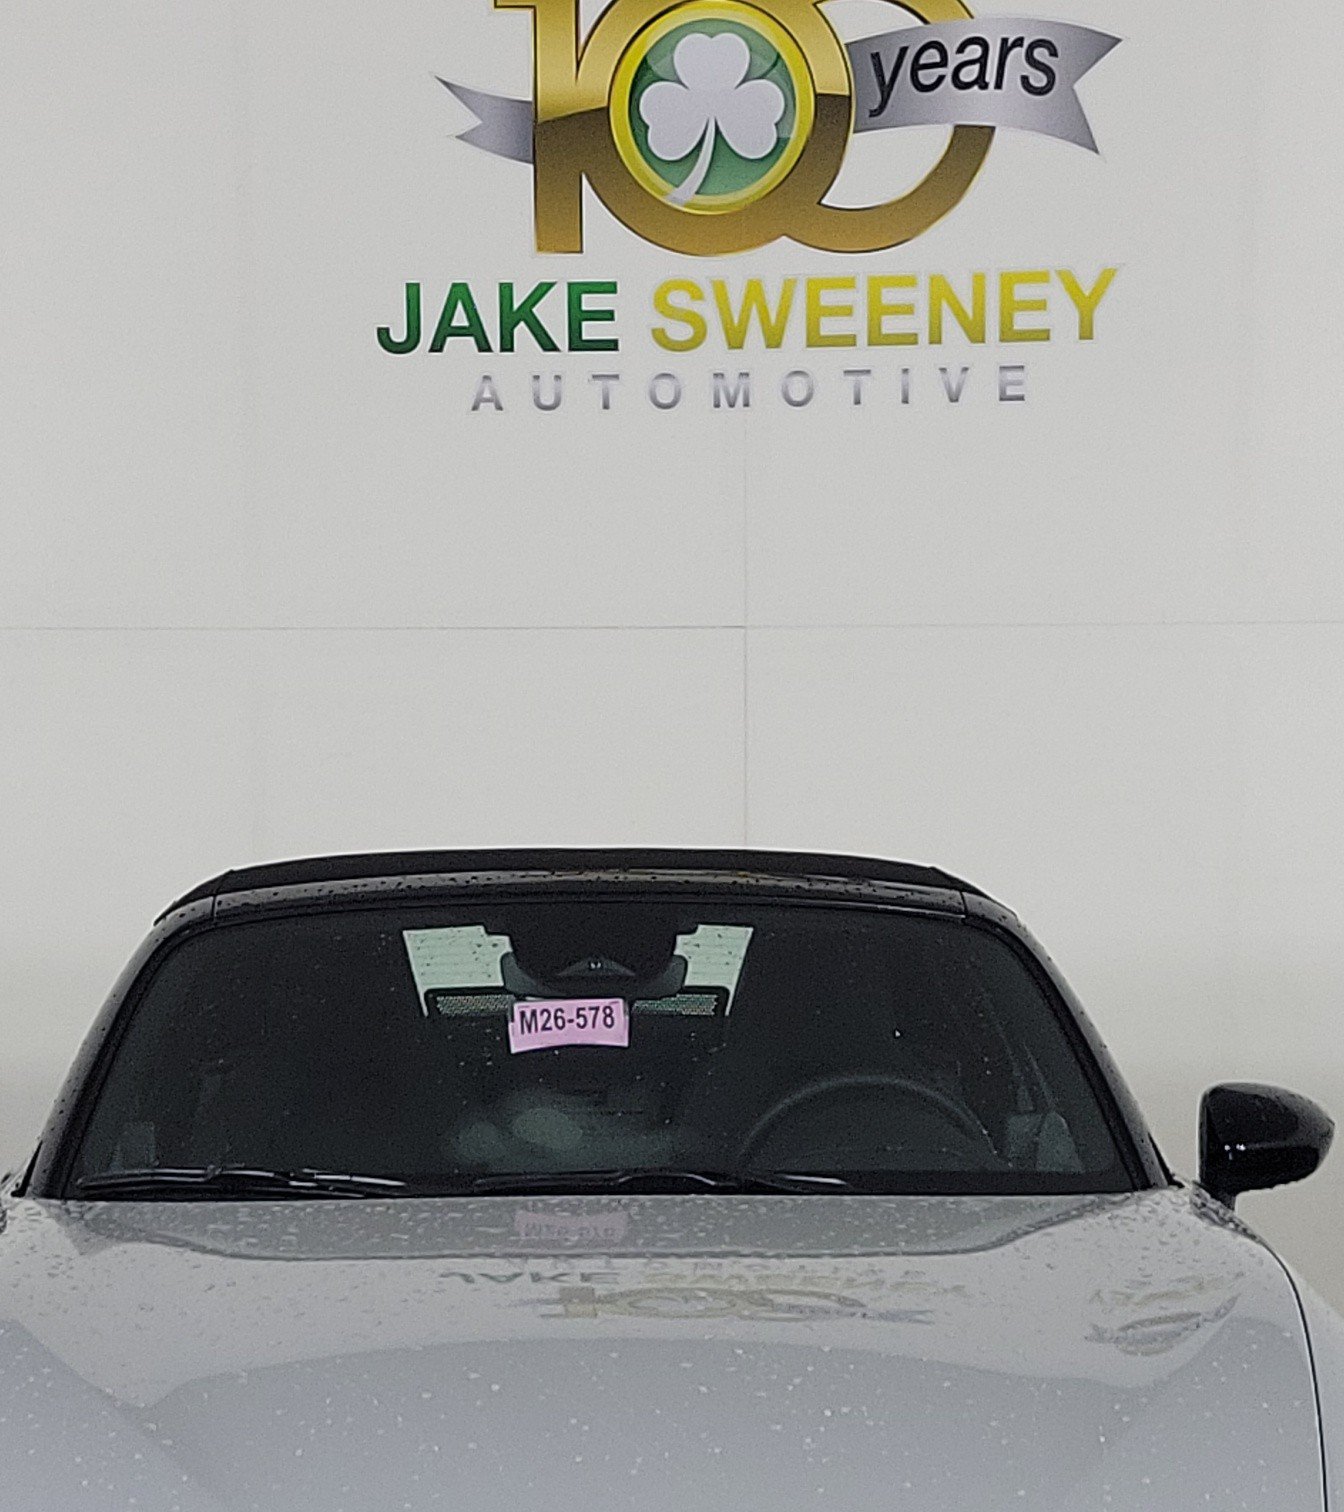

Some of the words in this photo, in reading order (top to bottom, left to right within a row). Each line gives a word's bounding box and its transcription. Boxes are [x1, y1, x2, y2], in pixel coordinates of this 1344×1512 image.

[868, 33, 1060, 118] years
[376, 280, 619, 354] JAKE
[650, 267, 1119, 353] SWEENEY
[471, 364, 1027, 413] AUTOMOTIVE
[519, 1005, 616, 1036] M26-578
